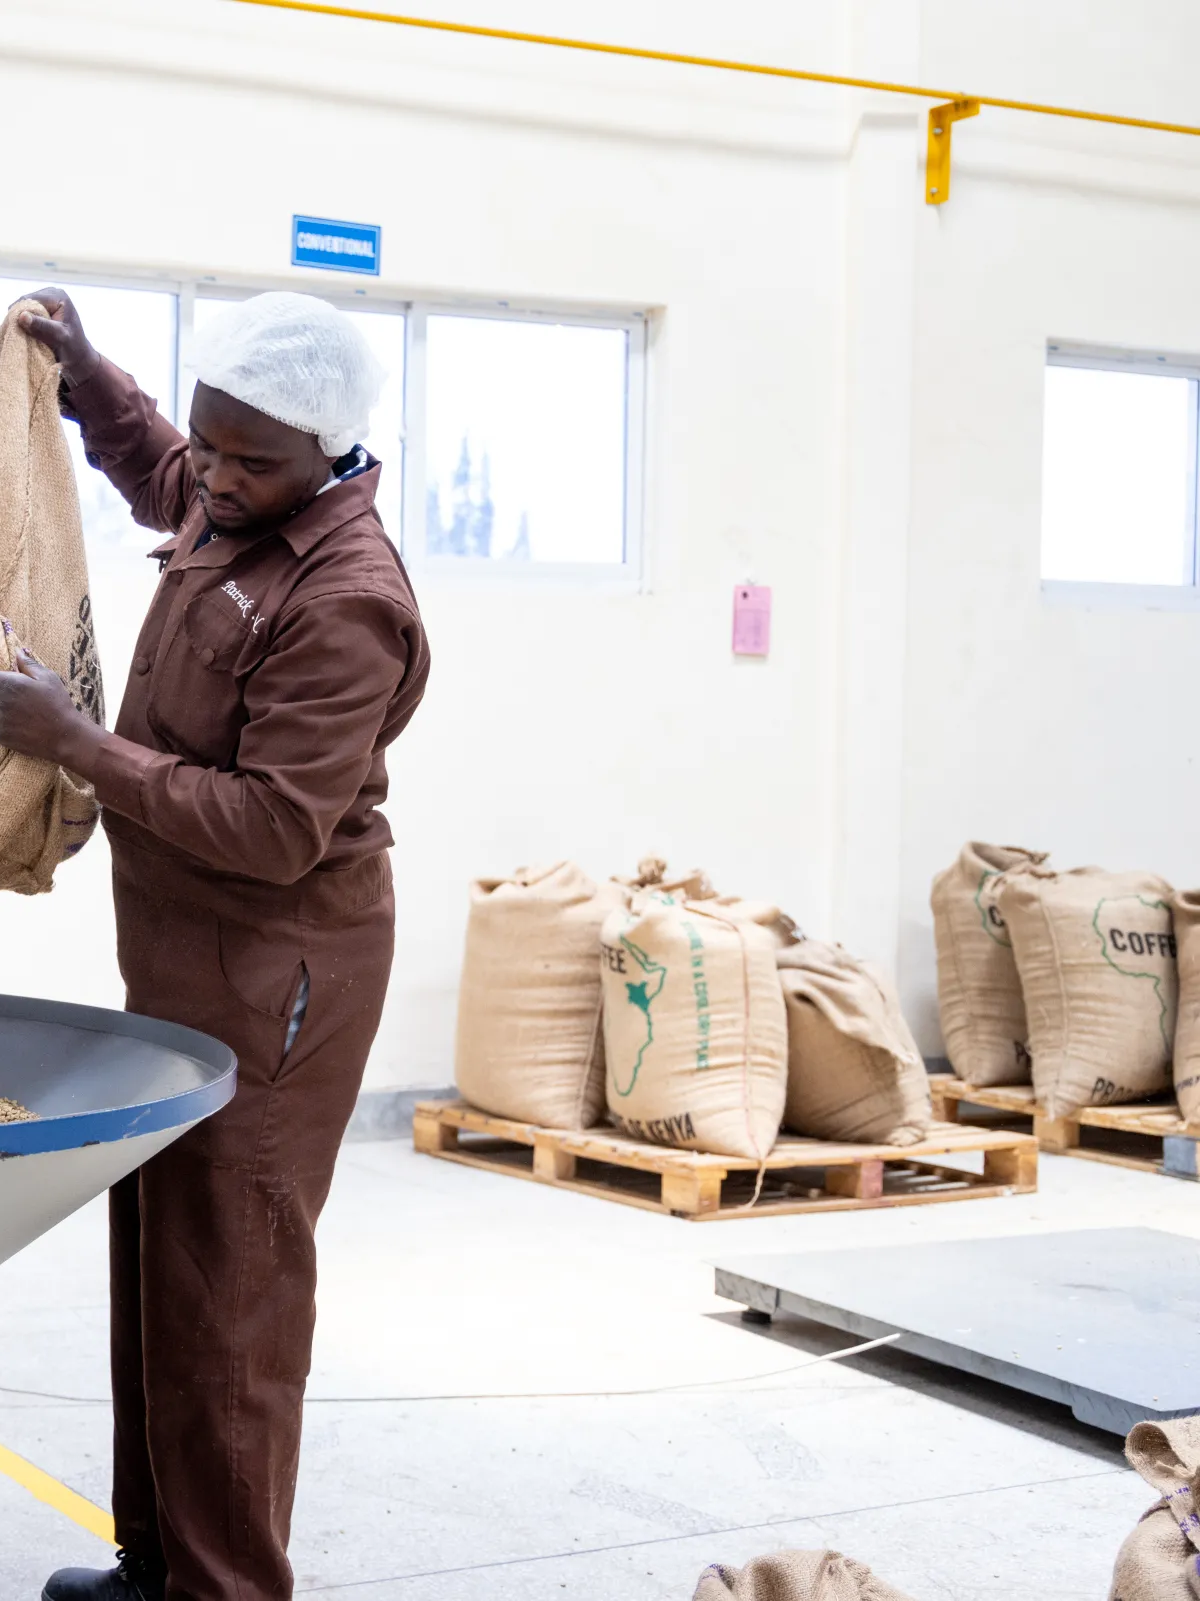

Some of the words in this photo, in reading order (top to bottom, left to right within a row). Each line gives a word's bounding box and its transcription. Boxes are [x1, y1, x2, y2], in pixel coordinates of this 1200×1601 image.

[297, 231, 375, 258] CONVENTIONAL
[220, 580, 255, 619] Patrick
[1109, 927, 1177, 958] COFF
[644, 1112, 697, 1144] KENYA
